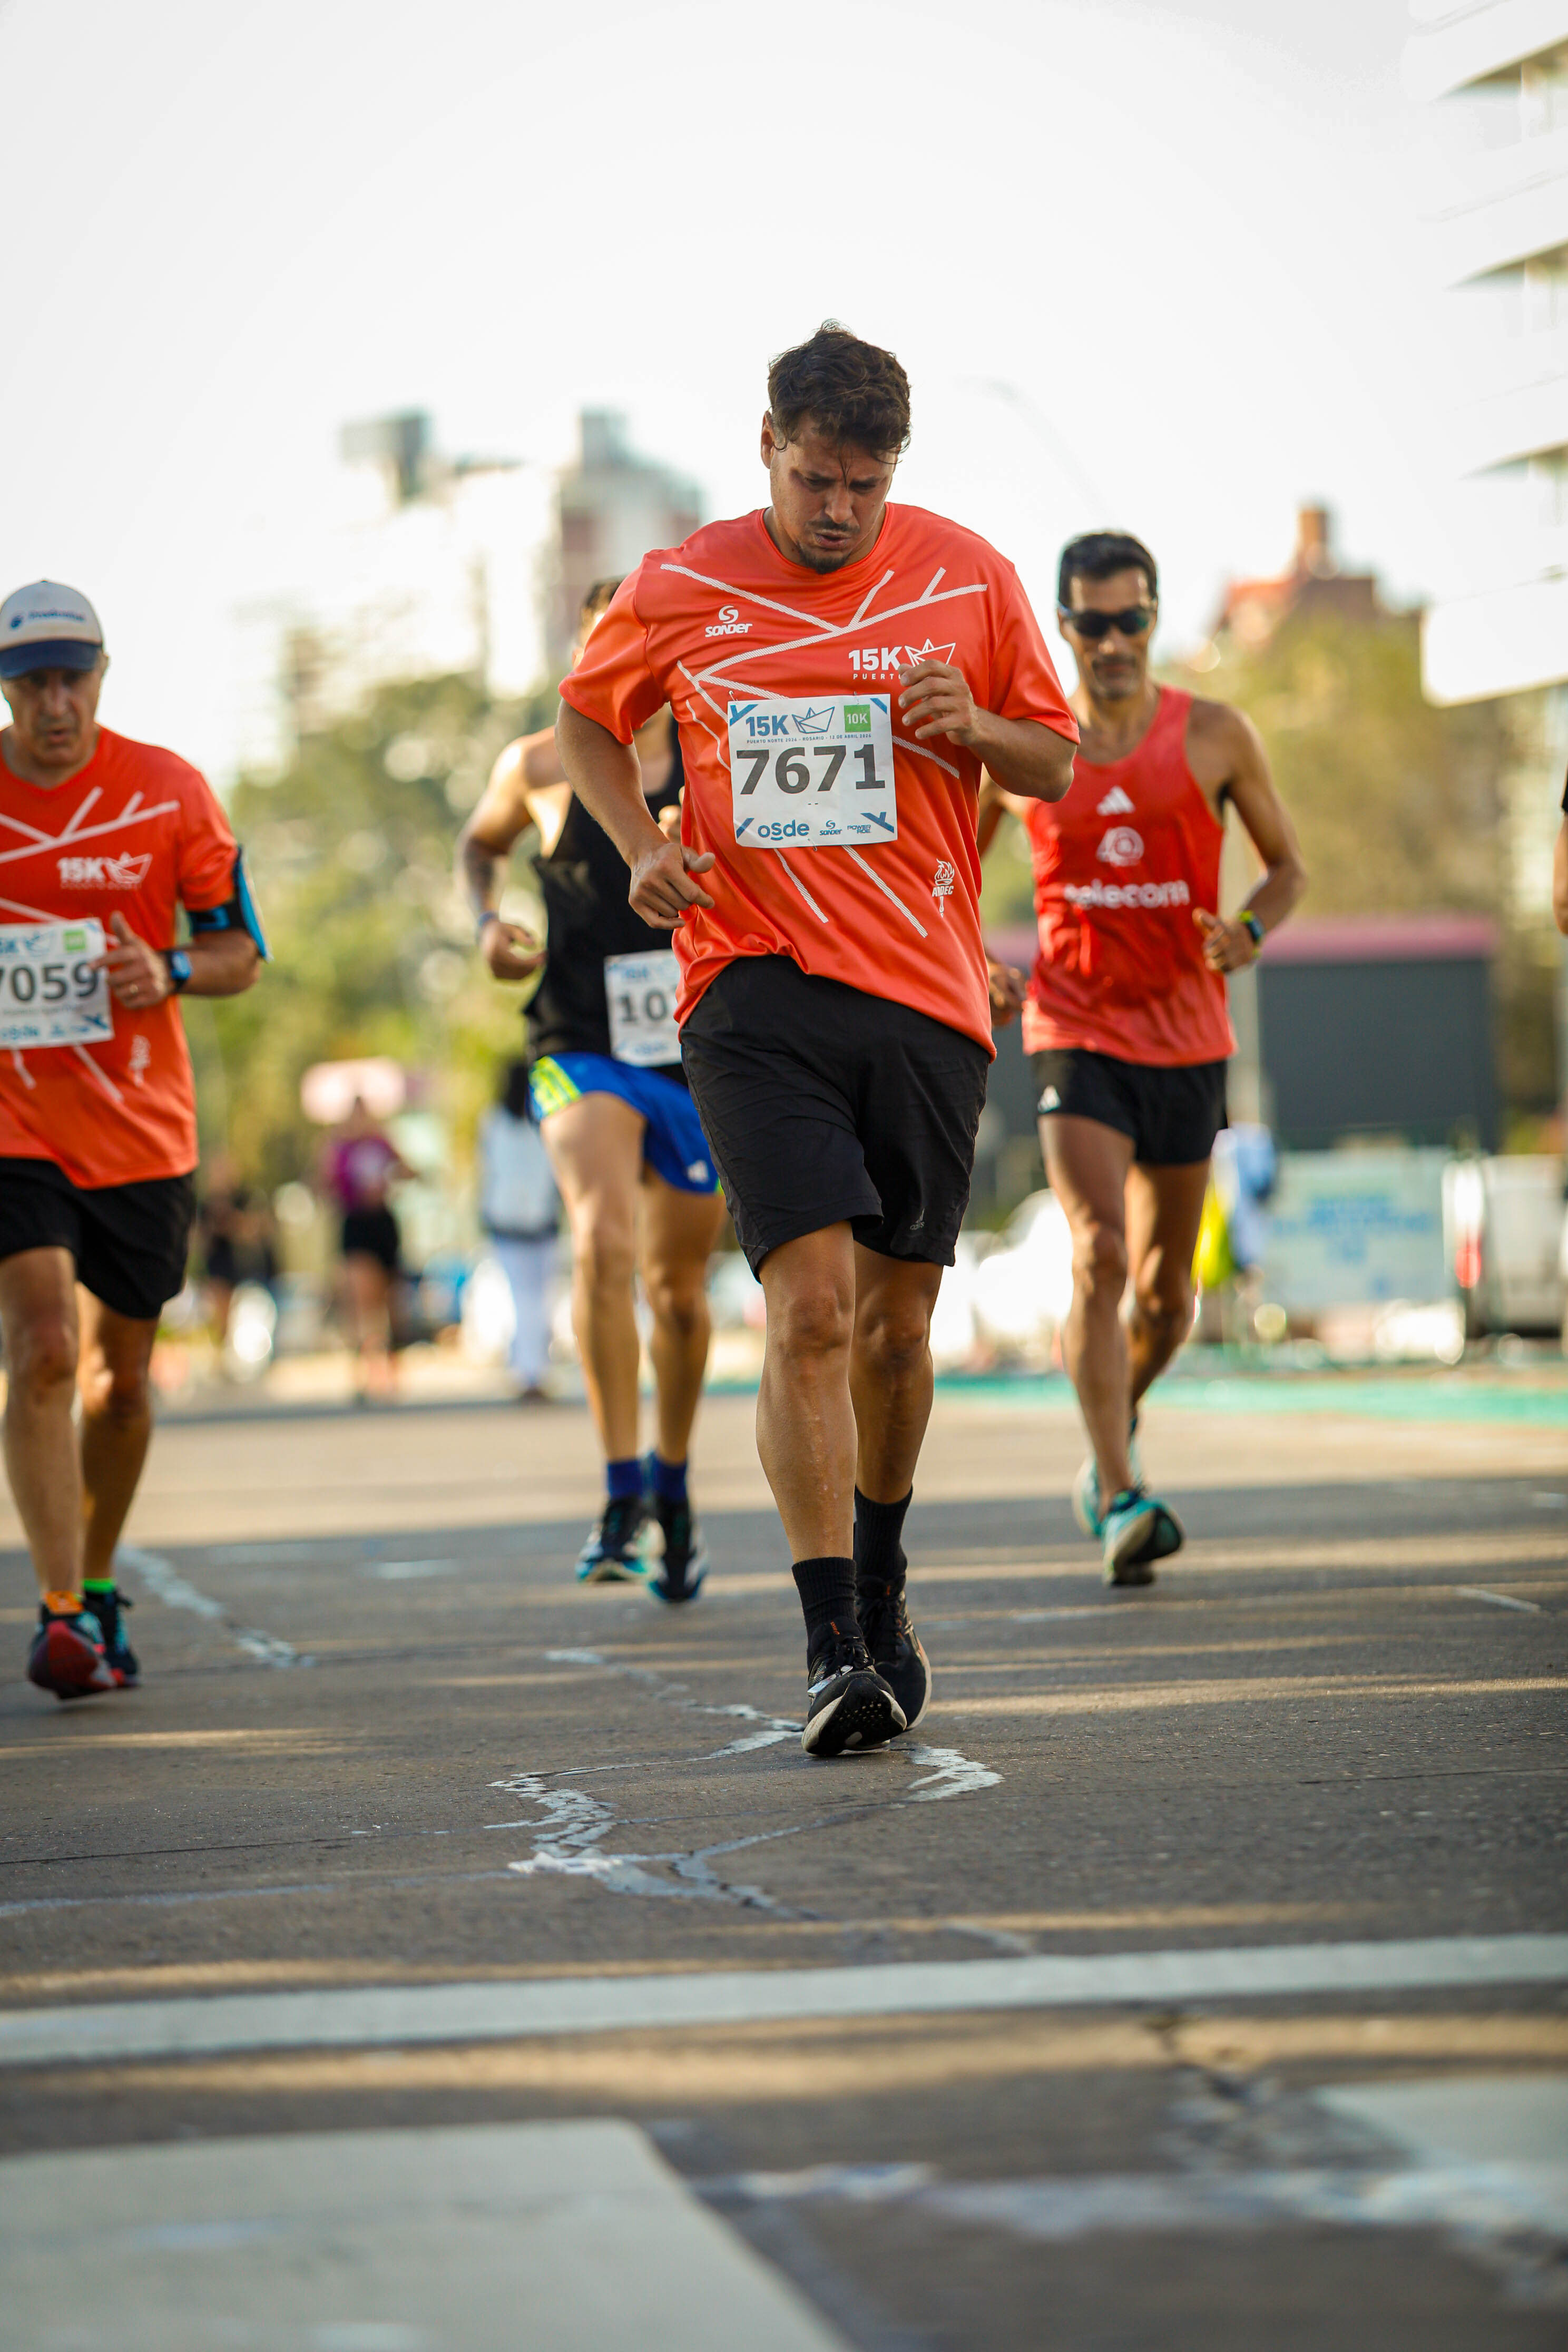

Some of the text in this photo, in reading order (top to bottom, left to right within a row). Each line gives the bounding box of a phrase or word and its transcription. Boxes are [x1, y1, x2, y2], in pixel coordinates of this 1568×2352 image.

[848, 646, 903, 671] 15K
[746, 714, 790, 737] 15K
[847, 713, 869, 725] 10K
[737, 744, 886, 795] 7671
[758, 819, 810, 838] osde
[0, 961, 100, 1003] 059
[619, 987, 678, 1024] 10
